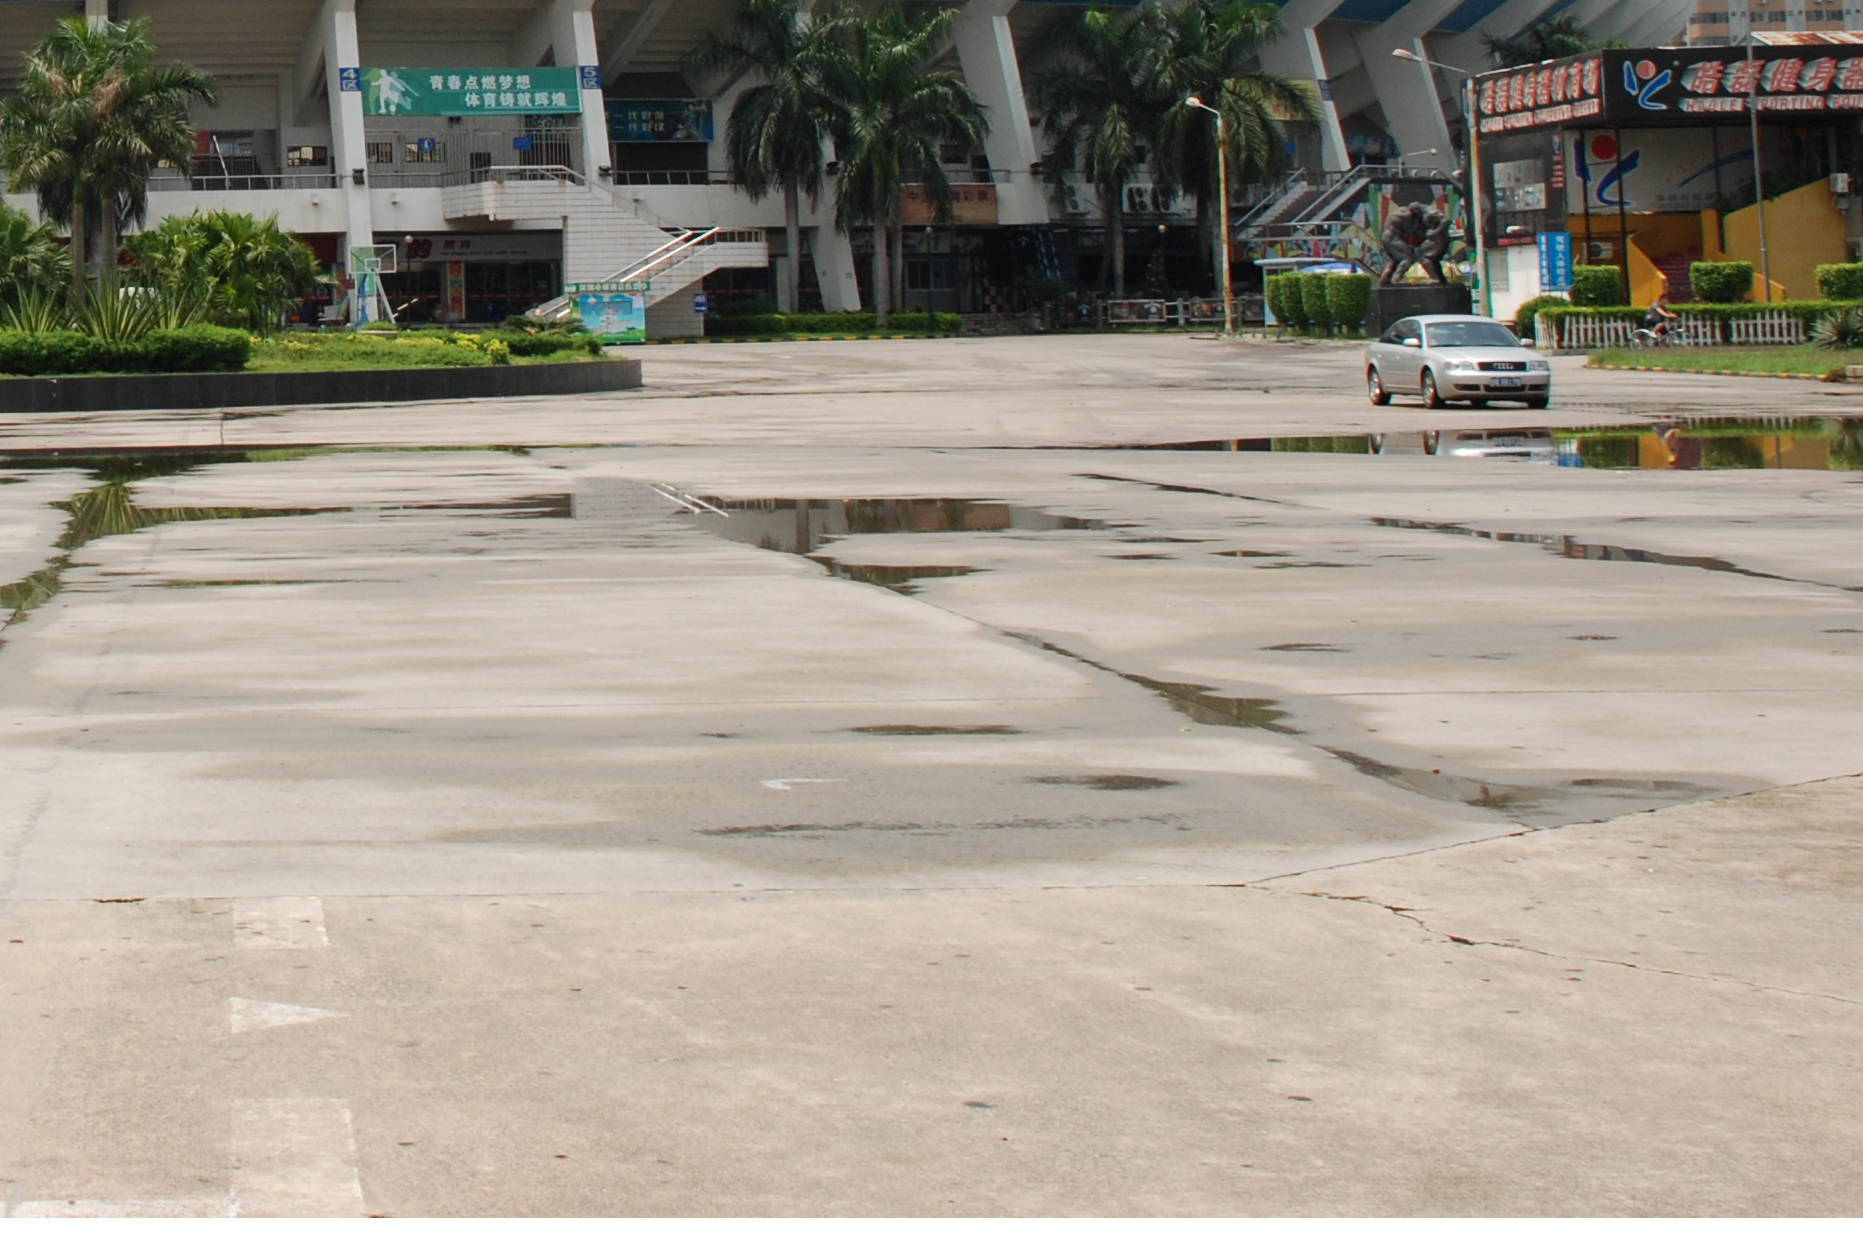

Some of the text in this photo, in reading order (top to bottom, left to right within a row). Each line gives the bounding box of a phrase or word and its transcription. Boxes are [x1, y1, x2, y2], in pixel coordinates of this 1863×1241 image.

[429, 74, 531, 90] 青春点燃梦想
[464, 91, 567, 107] 体育铸就辉煌
[1748, 95, 1826, 110] PORTING
[906, 189, 991, 204] 中国育彩票
